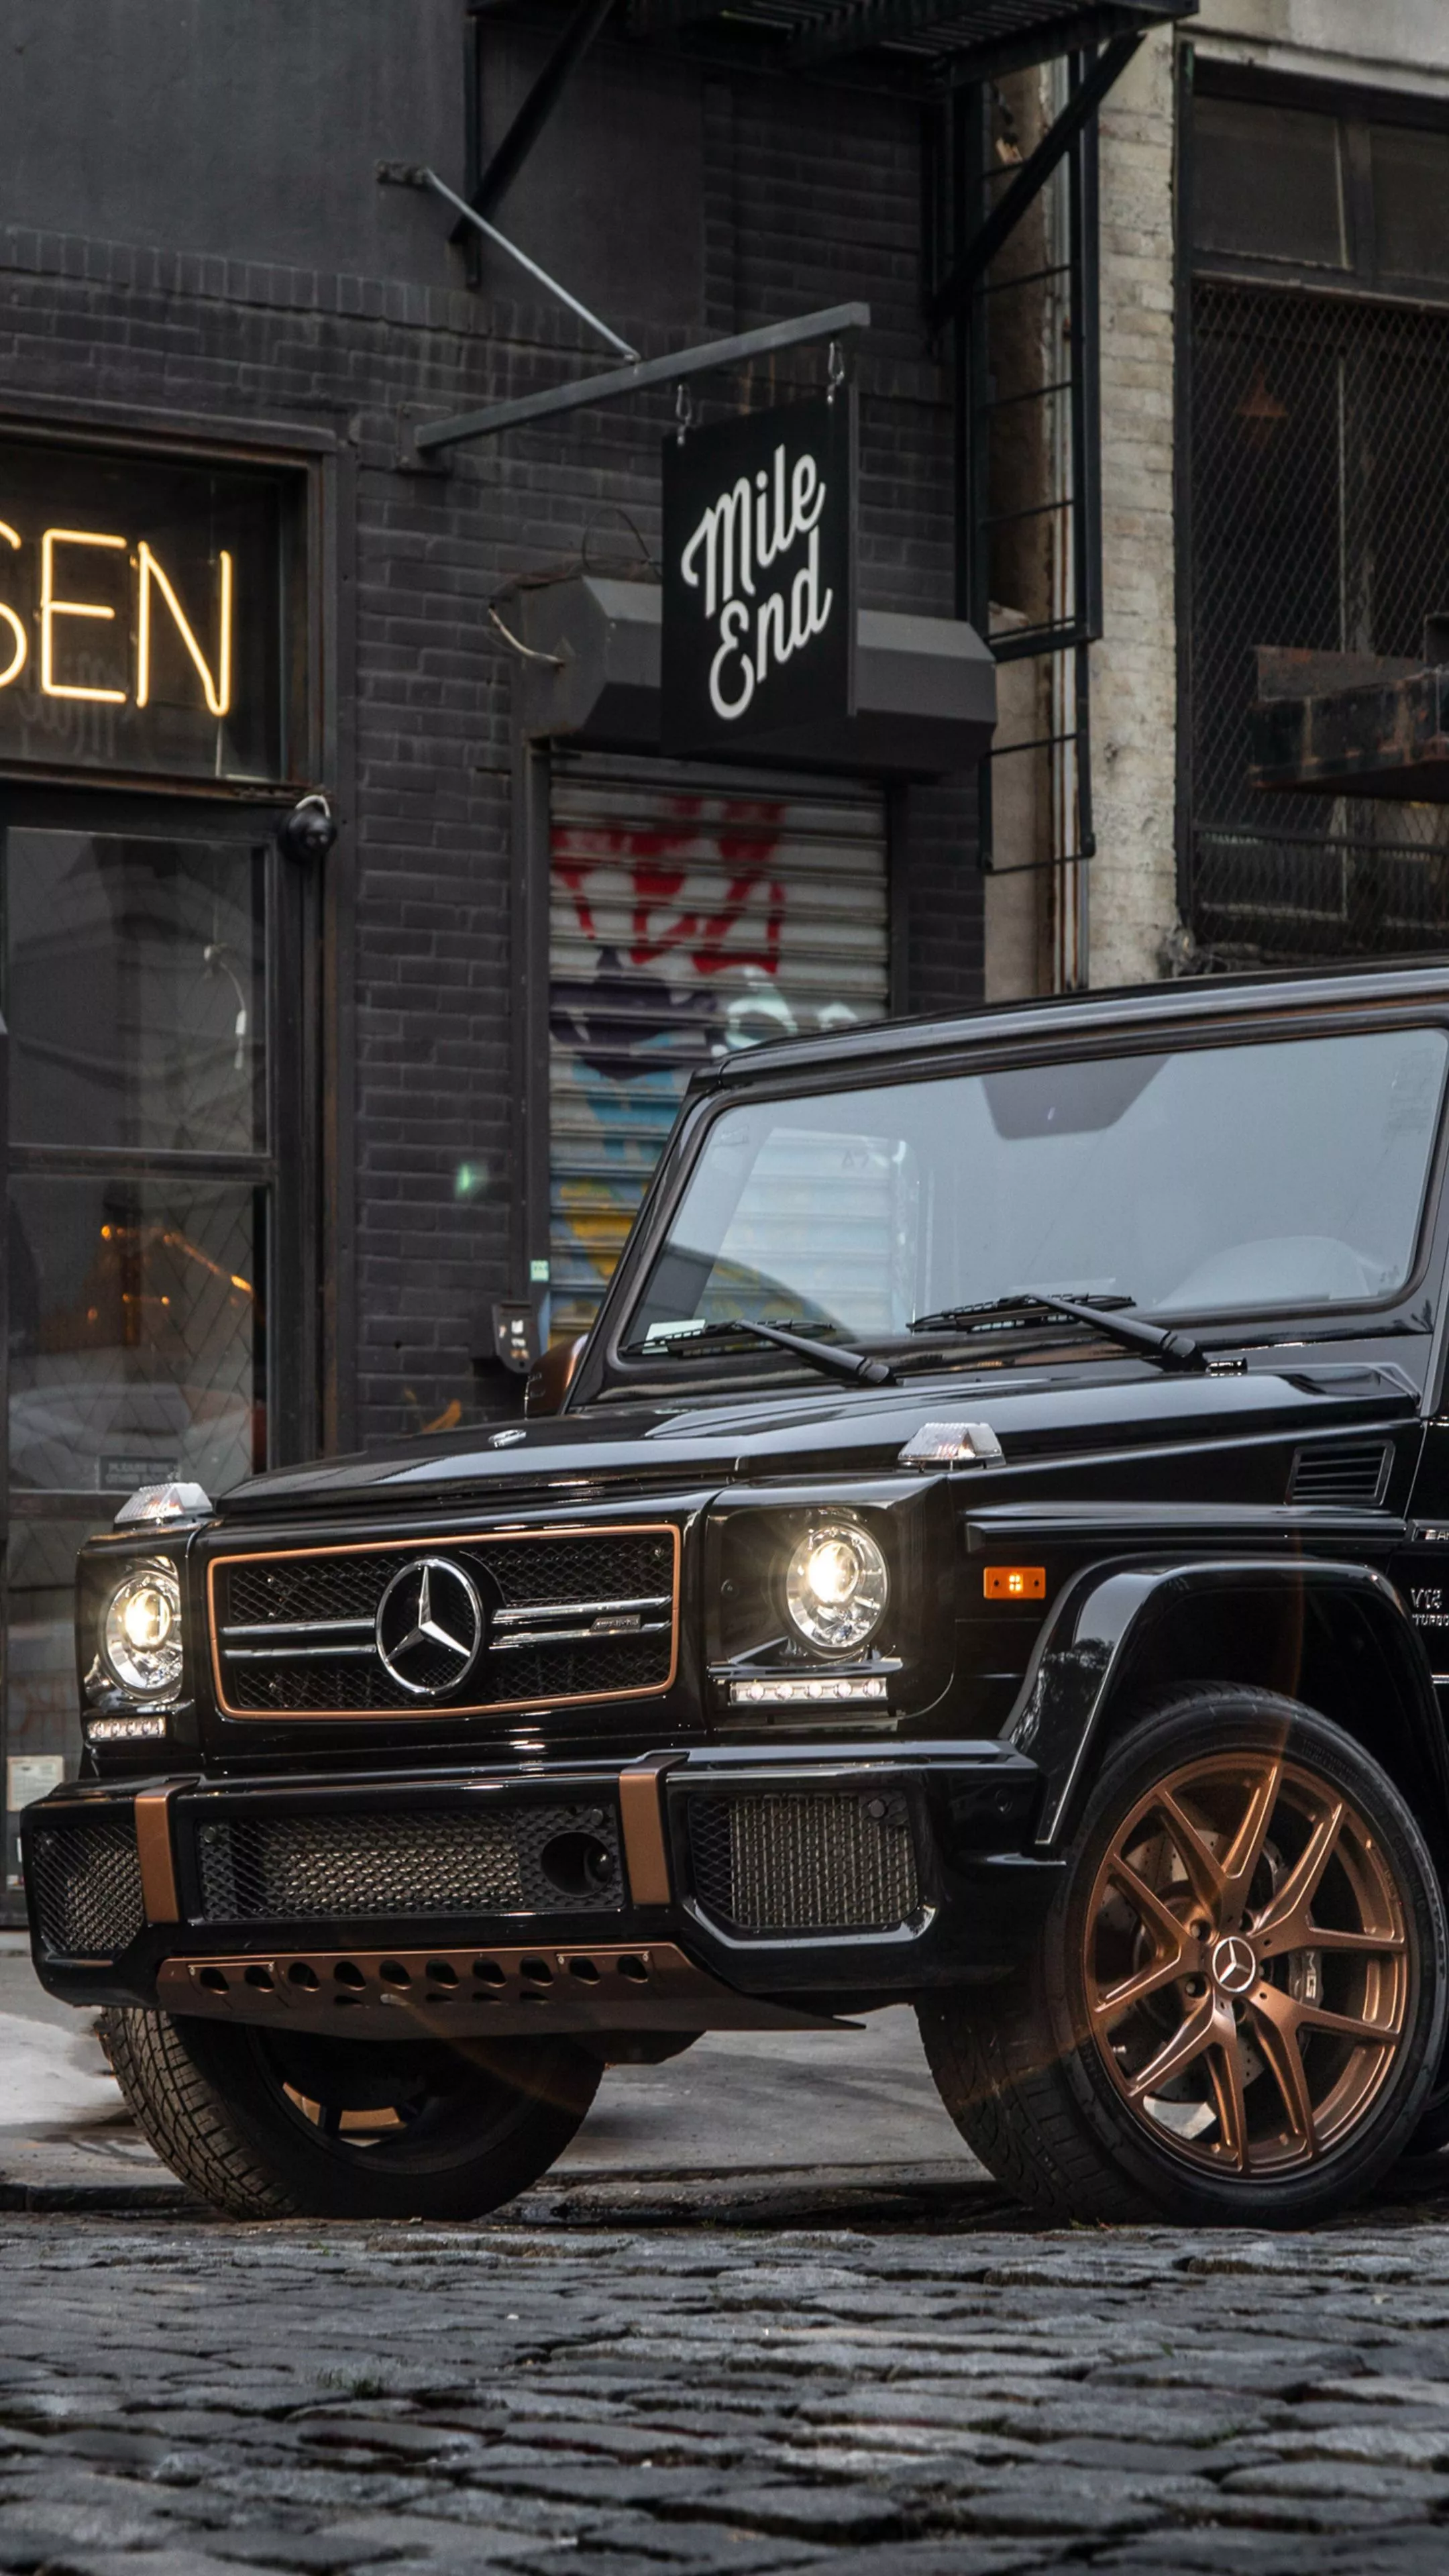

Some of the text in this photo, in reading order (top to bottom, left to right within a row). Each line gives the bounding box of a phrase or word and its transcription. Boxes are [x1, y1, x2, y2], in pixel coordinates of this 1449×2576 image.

[681, 443, 826, 619] Mile
[708, 525, 833, 720] End
[1411, 1588, 1442, 1609] V12
[1305, 1950, 1317, 1999] MG
